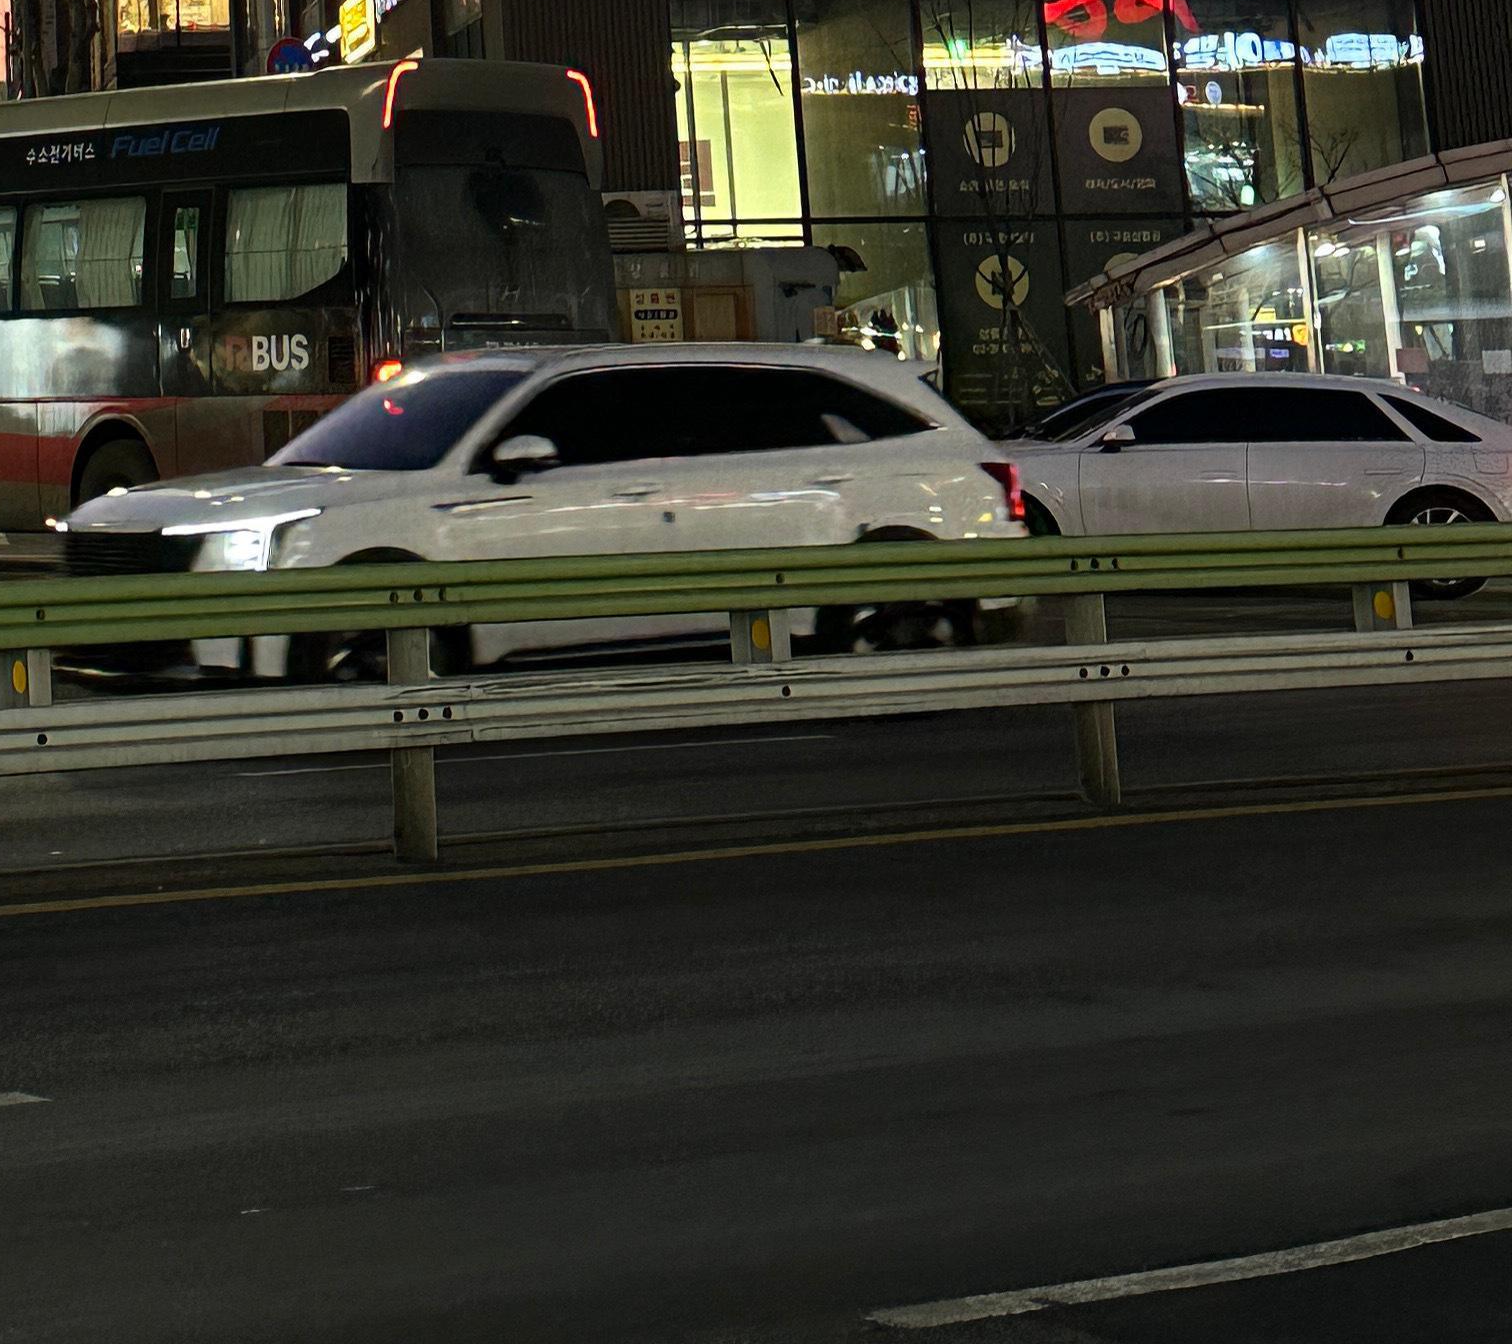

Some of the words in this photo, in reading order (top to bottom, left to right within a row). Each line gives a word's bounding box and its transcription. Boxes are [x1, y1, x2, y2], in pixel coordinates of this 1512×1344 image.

[26, 141, 96, 165] 수소전기버스
[111, 130, 169, 159] Fuel
[170, 125, 221, 155] Cell
